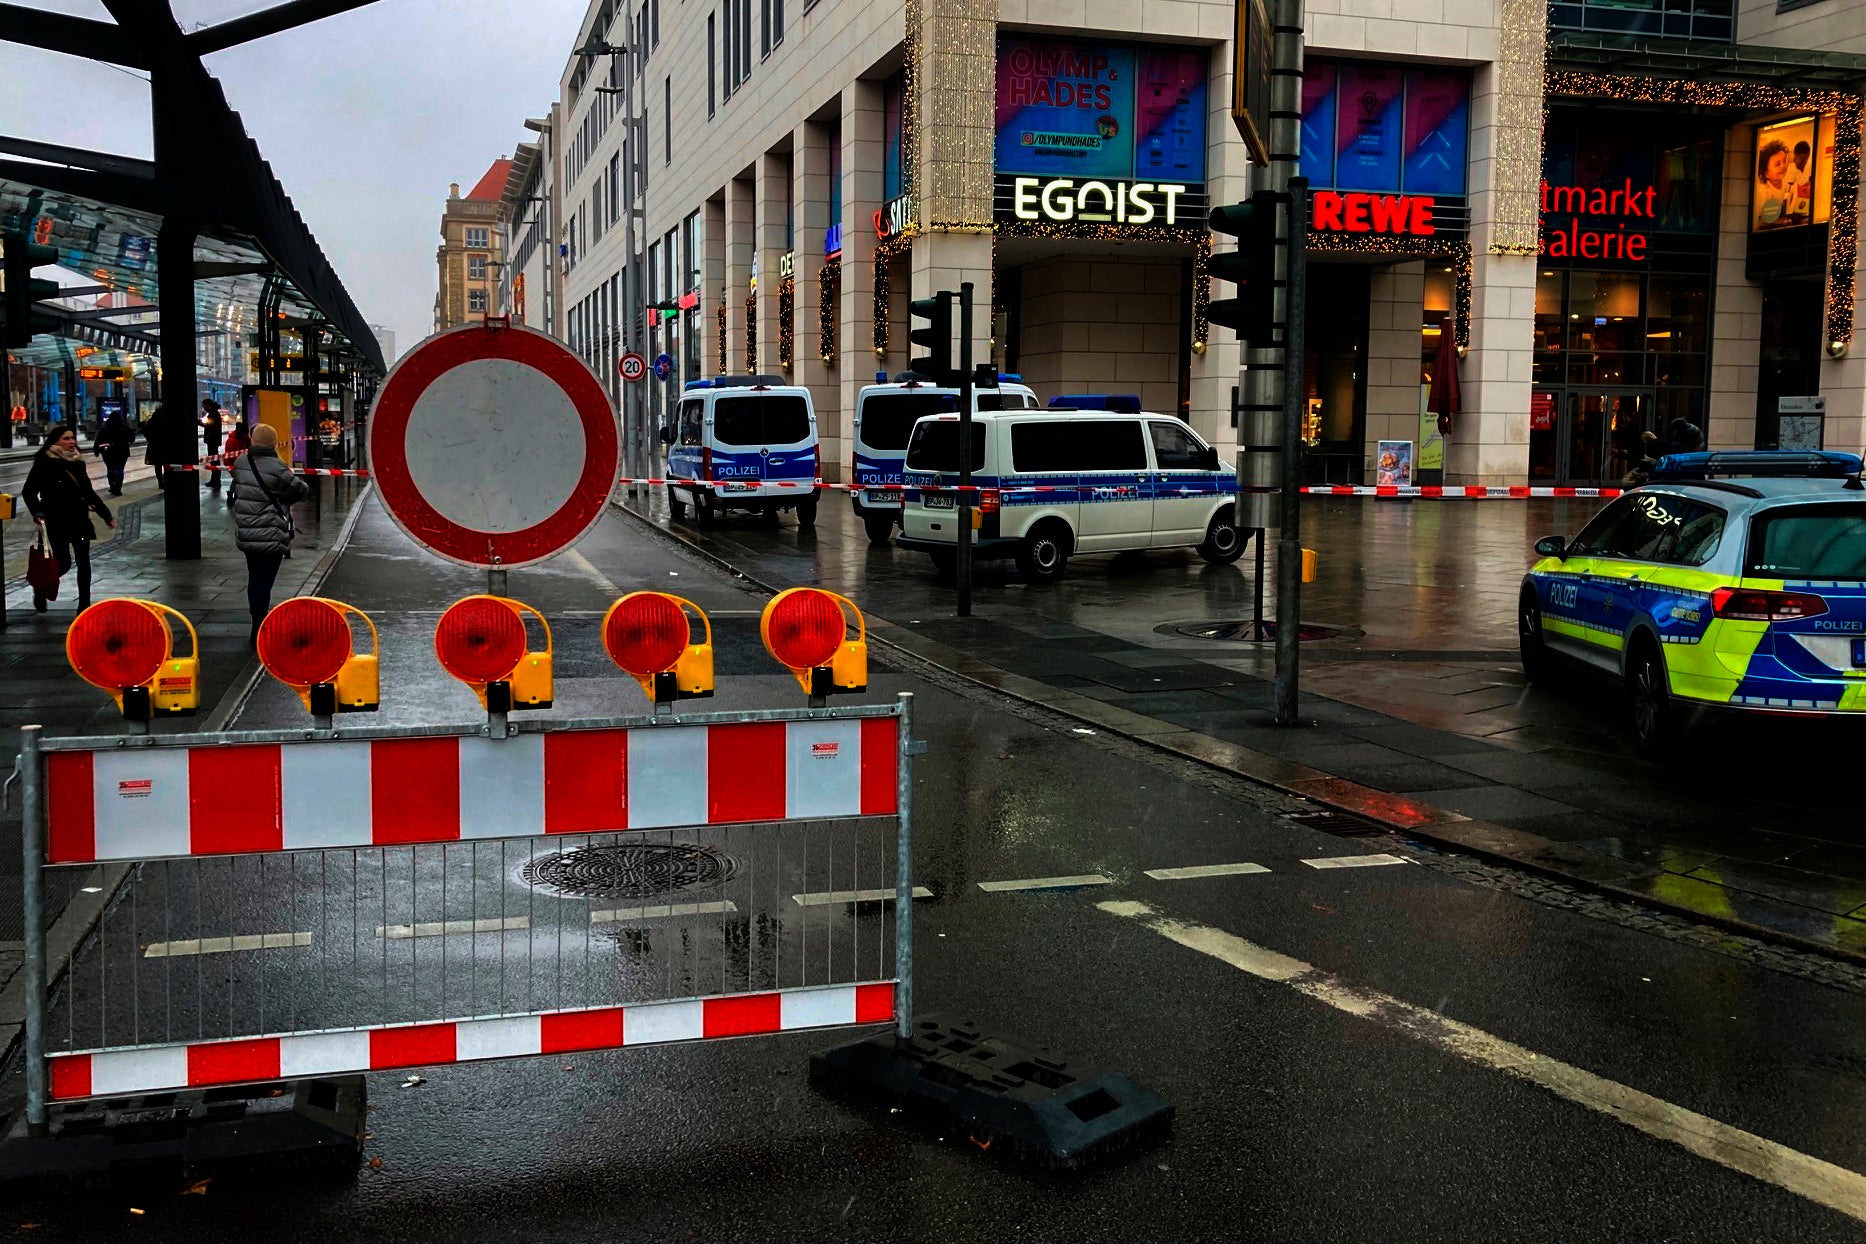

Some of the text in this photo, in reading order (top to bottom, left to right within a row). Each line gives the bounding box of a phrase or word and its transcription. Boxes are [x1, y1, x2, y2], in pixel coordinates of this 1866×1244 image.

[1009, 49, 1108, 80] OLYMP
[1010, 77, 1112, 110] HADES
[1015, 178, 1186, 225] EGOIST
[1313, 191, 1435, 235] REWE
[1537, 218, 1647, 260] alerie
[625, 360, 640, 373] 20
[718, 466, 760, 476] POLIZEI
[904, 475, 933, 486] POLIZEI
[1091, 485, 1139, 499] POLIZEI
[1550, 582, 1579, 609] POLIZEI
[1814, 620, 1863, 630] POLIZEI
